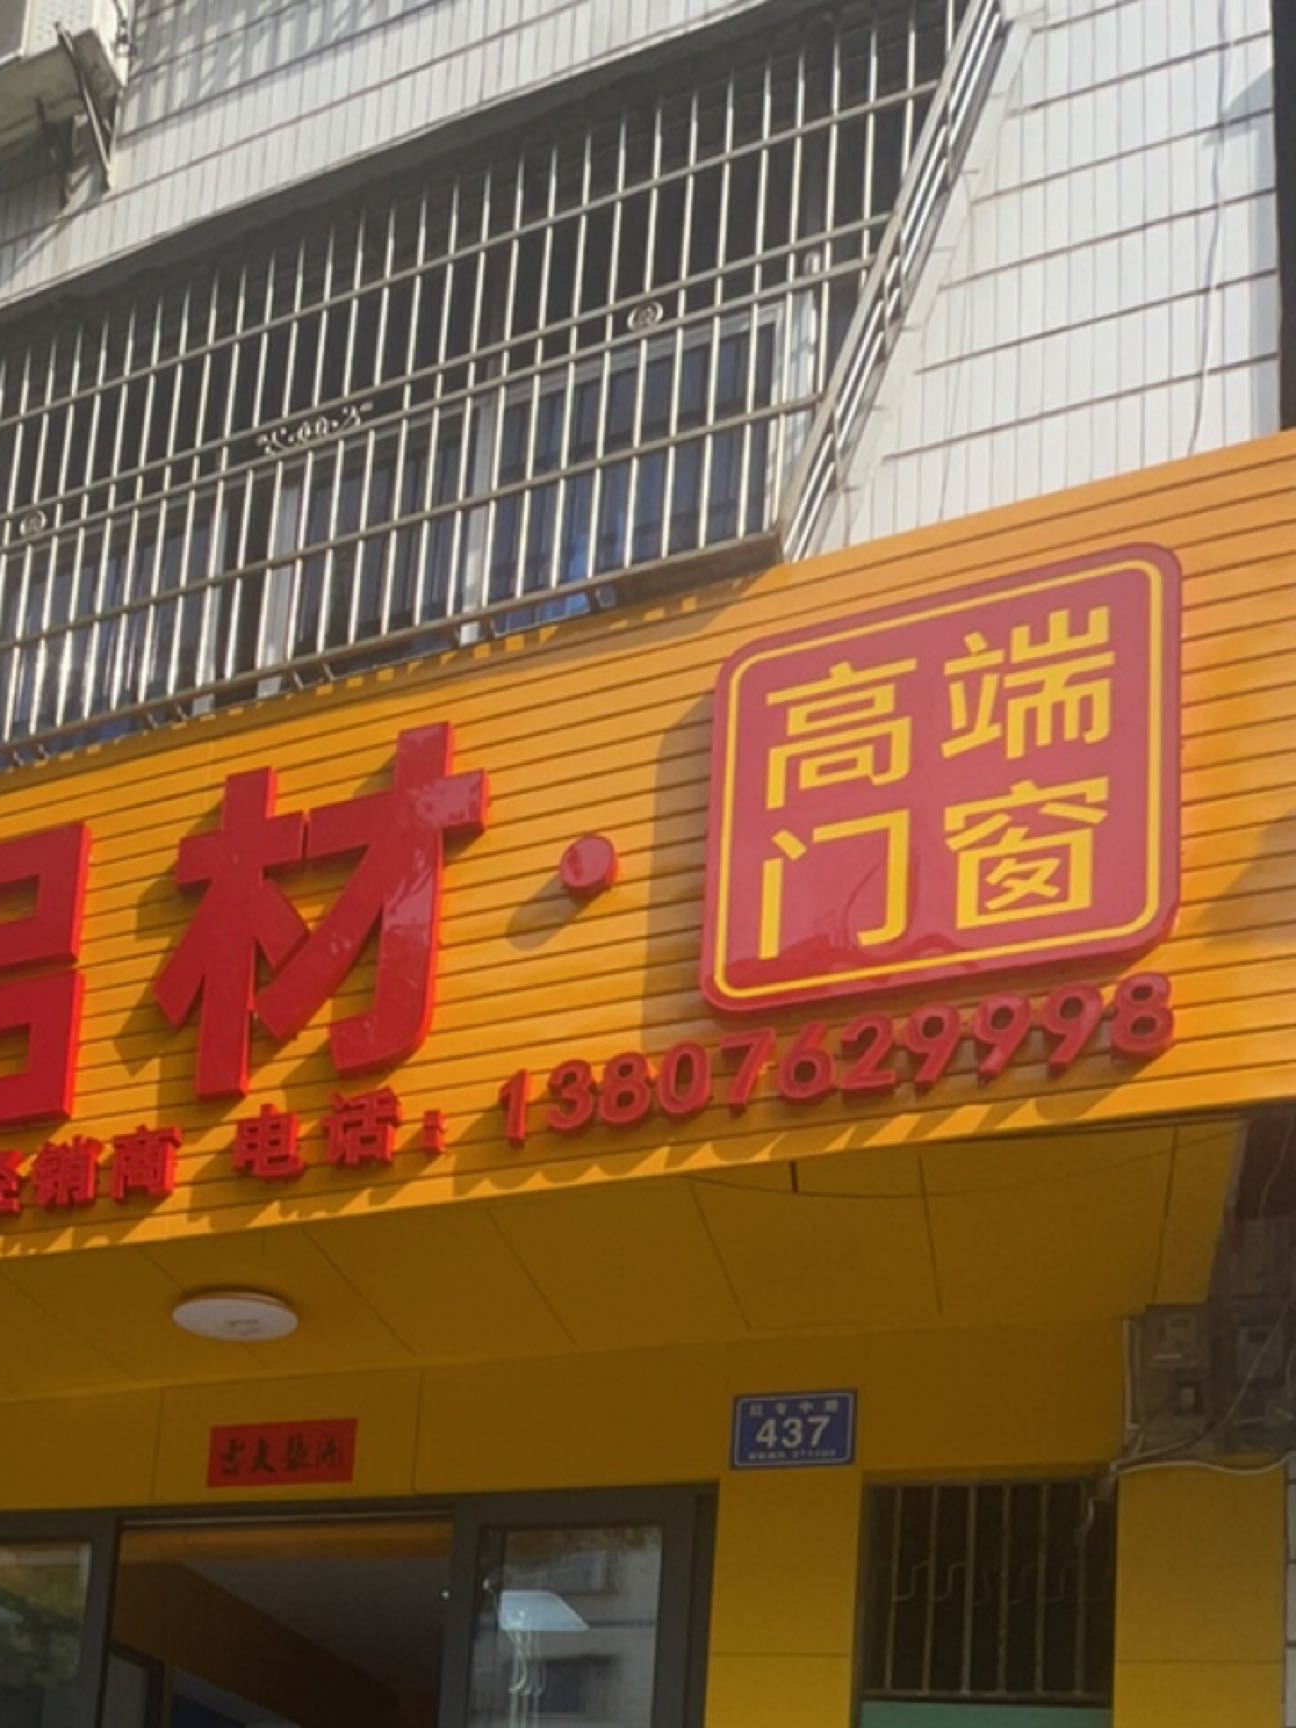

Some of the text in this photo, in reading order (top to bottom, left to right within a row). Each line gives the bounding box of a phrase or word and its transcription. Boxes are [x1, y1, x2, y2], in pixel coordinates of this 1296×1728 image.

[762, 606, 1116, 808] 高端
[758, 776, 1112, 960] 门窗
[498, 972, 1174, 1144] 13807629998
[755, 1414, 831, 1449] 437
